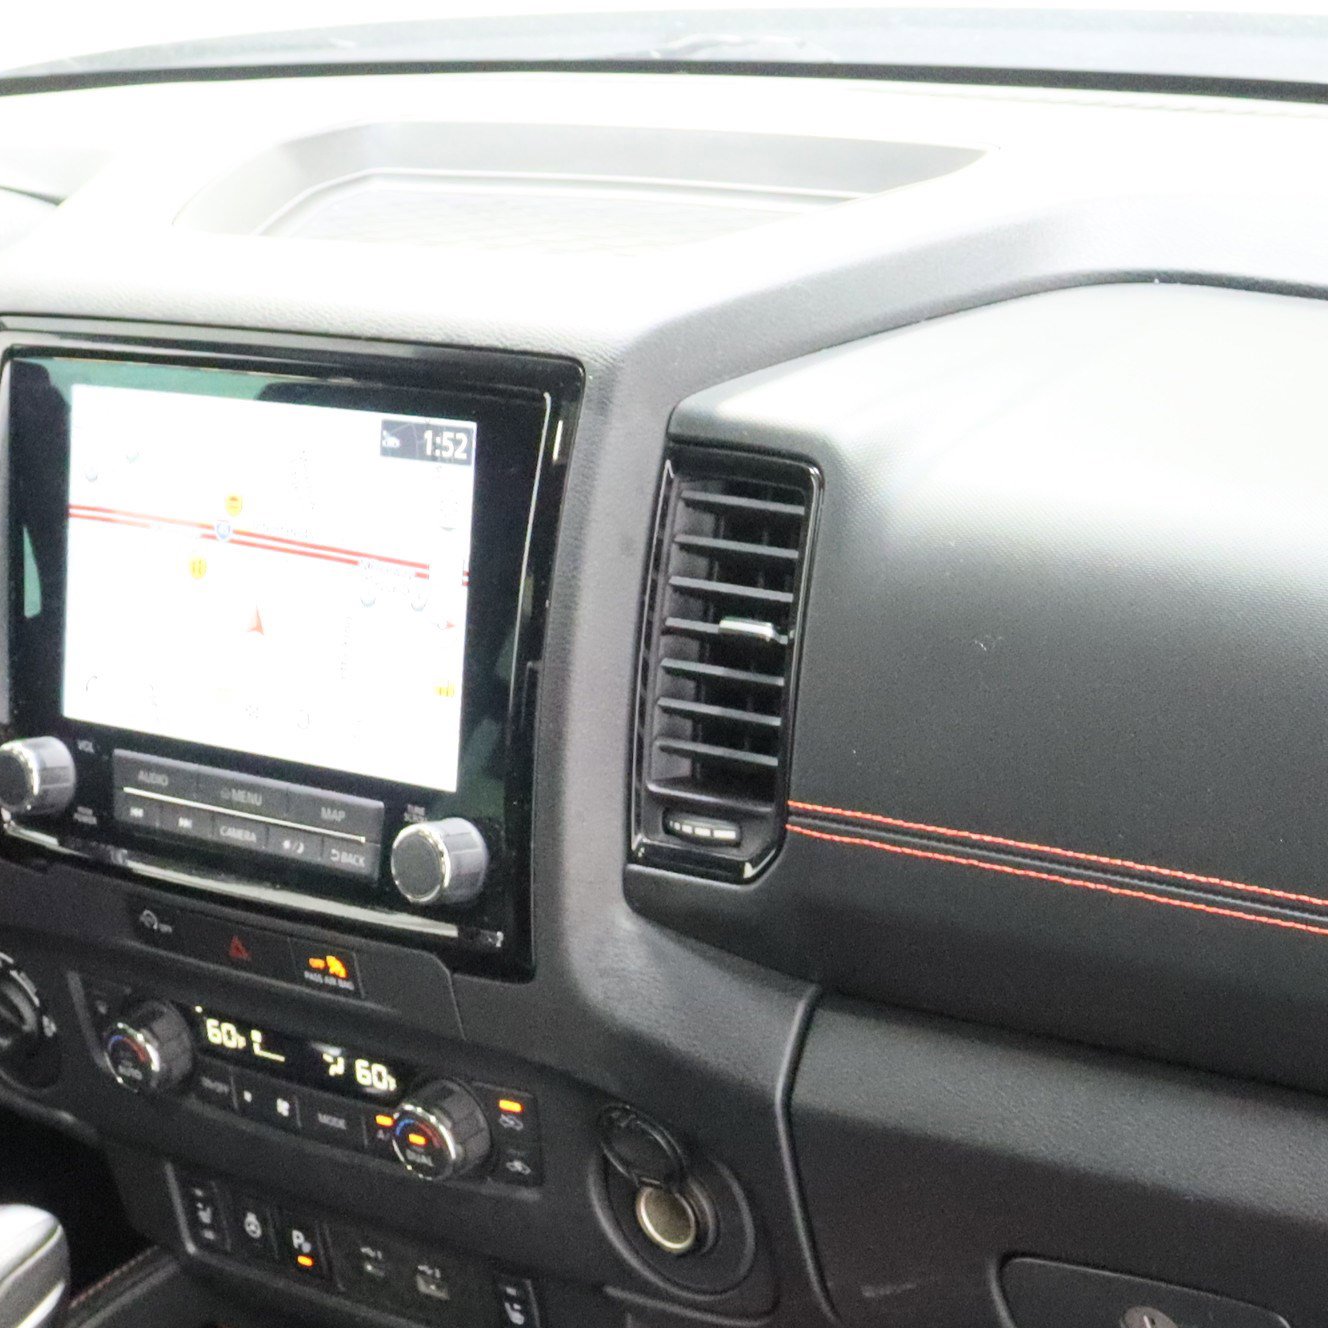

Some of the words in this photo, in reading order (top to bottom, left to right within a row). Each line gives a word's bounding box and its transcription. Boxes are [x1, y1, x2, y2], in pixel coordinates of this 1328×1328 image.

[423, 429, 469, 459] 1:52
[137, 769, 169, 787] AUDIO
[231, 788, 263, 807] MENU
[321, 806, 346, 822] MAP
[219, 826, 258, 843] CAMERA
[341, 851, 366, 868] BACK
